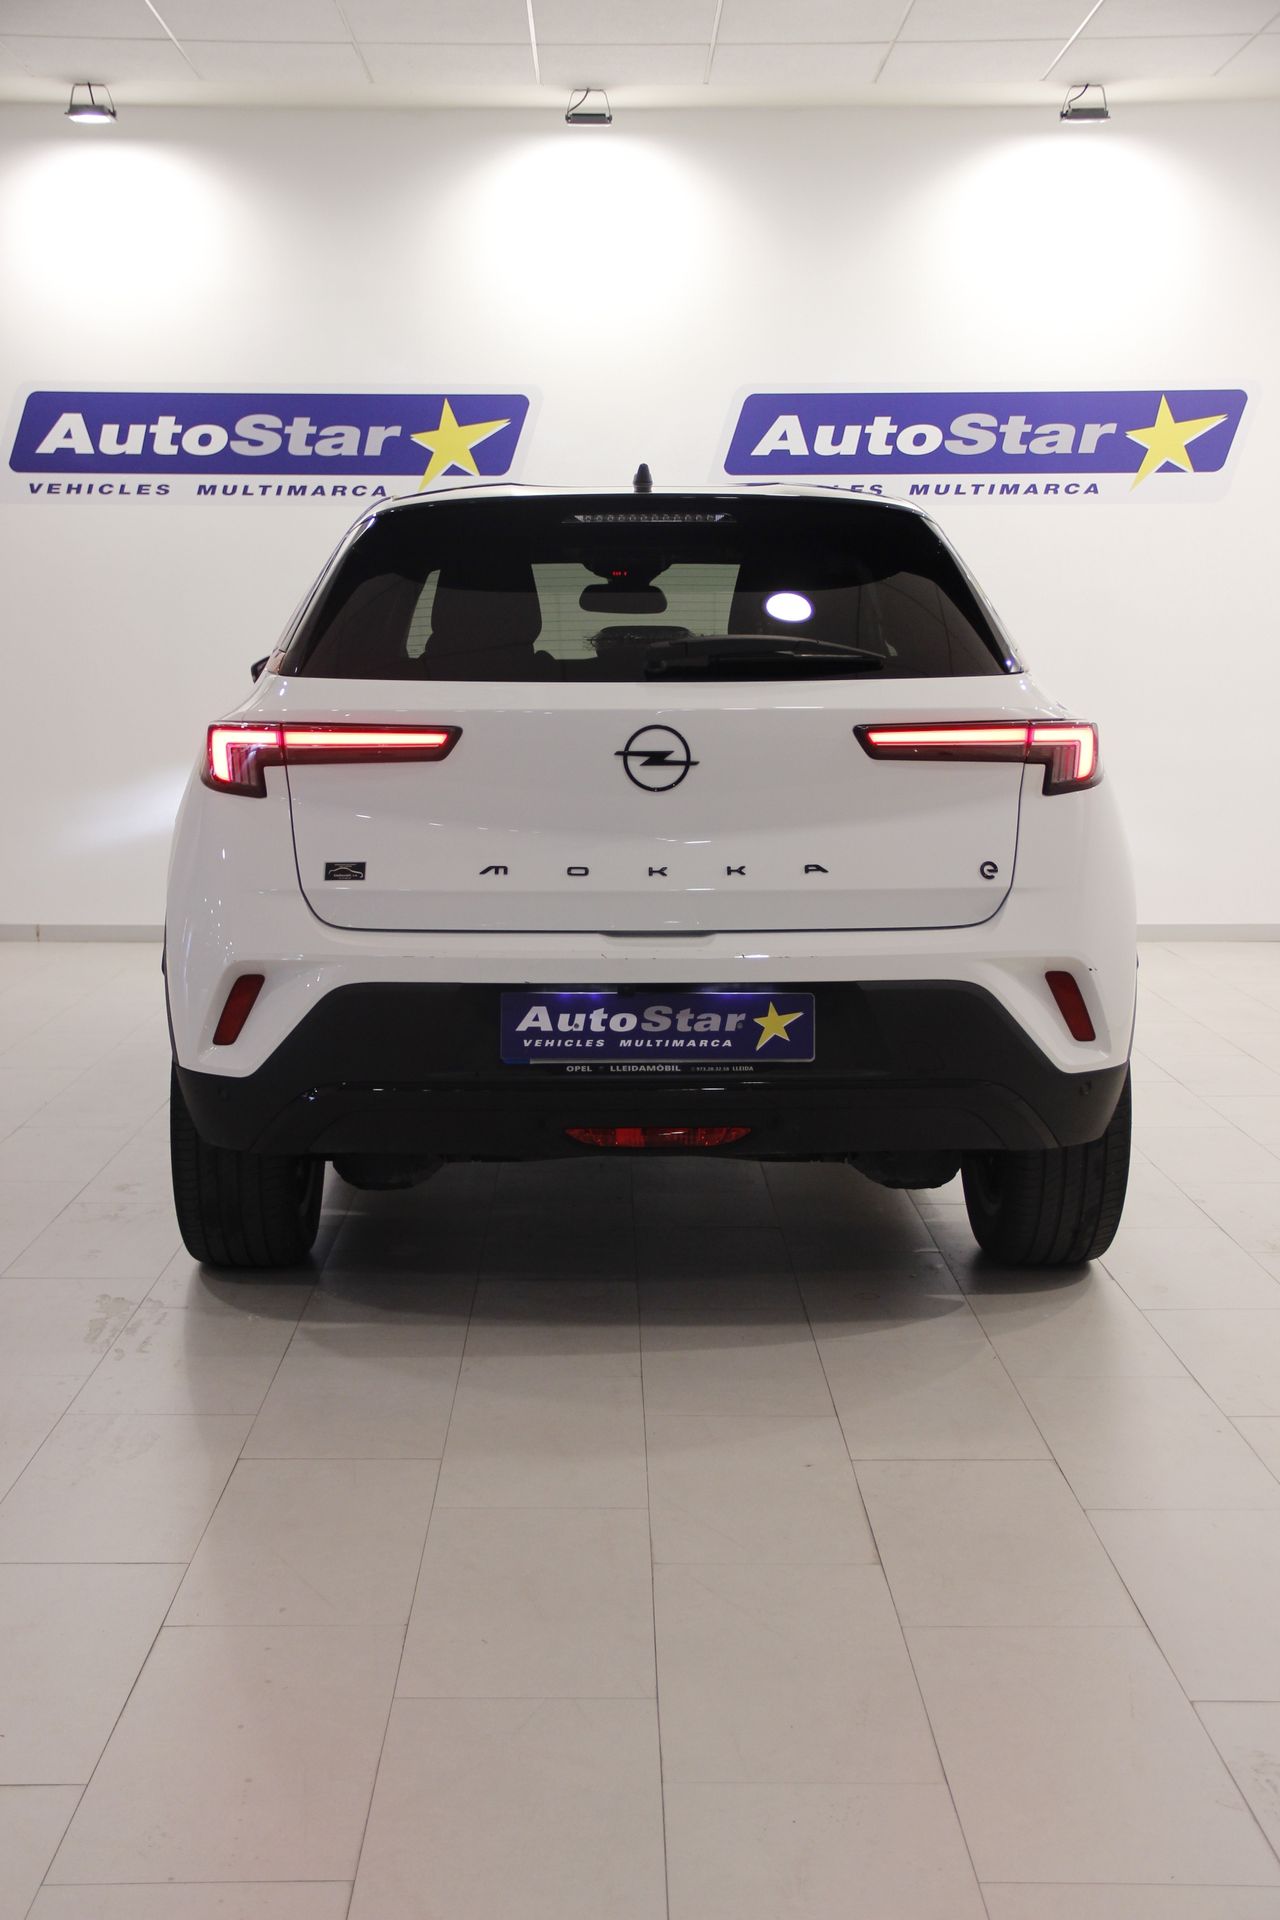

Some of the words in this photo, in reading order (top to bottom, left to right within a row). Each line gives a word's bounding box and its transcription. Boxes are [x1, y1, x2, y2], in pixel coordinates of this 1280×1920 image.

[35, 412, 402, 457] AutoStar
[750, 412, 1118, 457] AutoStar
[28, 483, 171, 496] VEHICLES
[196, 484, 387, 497] MULTIMARCA
[909, 483, 1100, 496] MULTIMARCA
[515, 1005, 746, 1033] AutoStar
[523, 1039, 605, 1048] VEHICLES
[619, 1039, 733, 1048] MULTIMARCA
[566, 1065, 593, 1073] OPEL
